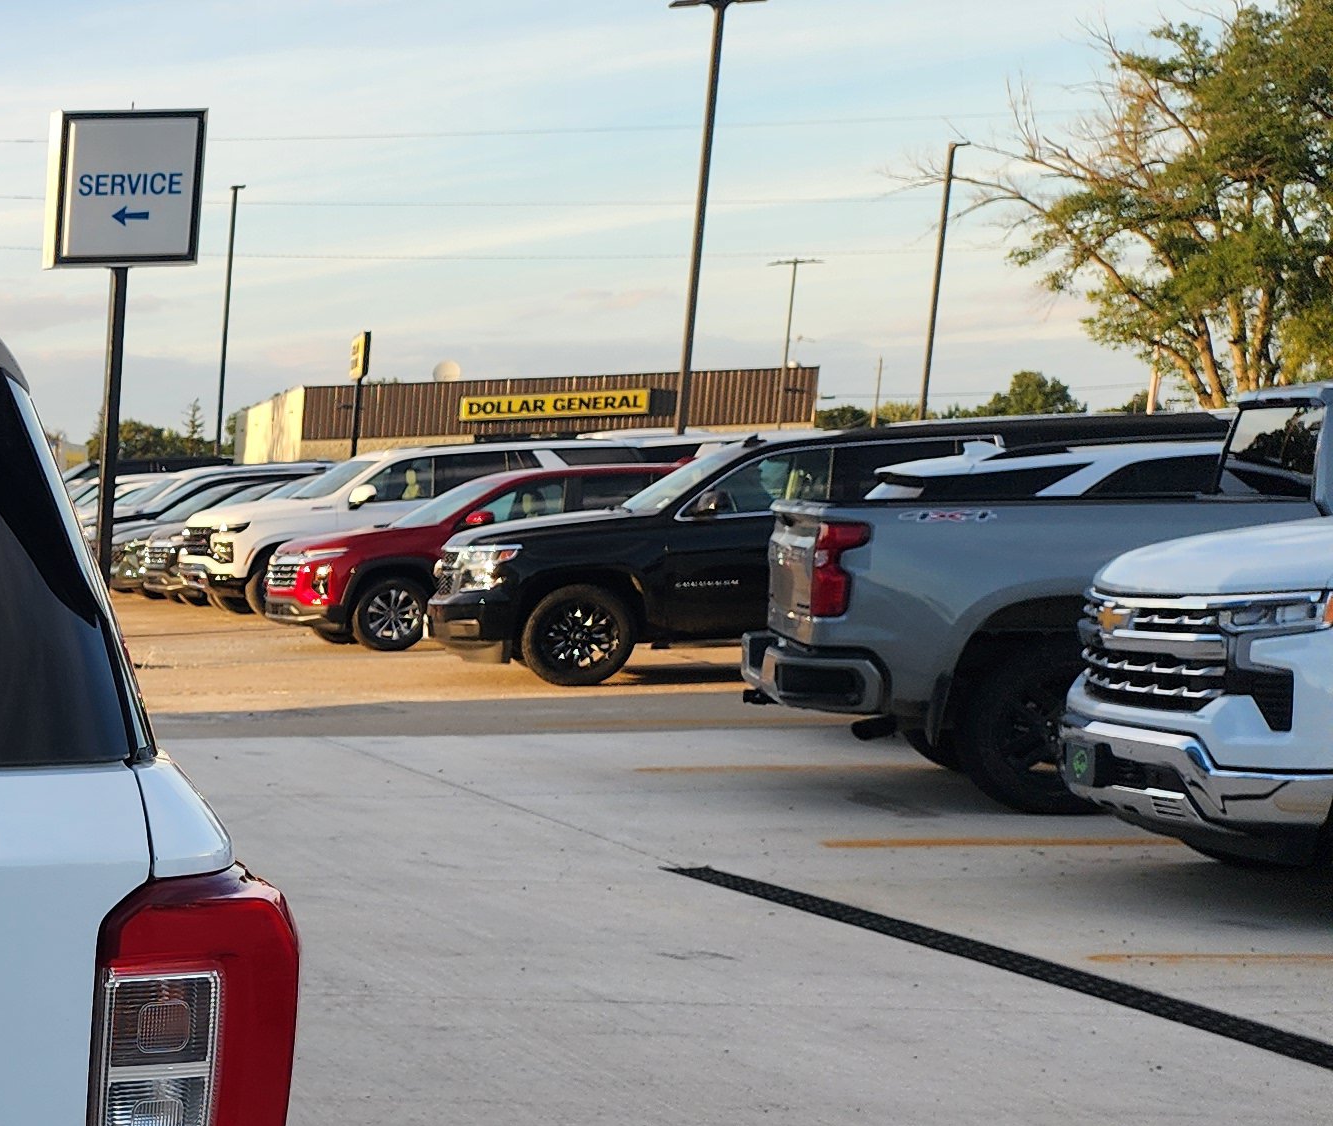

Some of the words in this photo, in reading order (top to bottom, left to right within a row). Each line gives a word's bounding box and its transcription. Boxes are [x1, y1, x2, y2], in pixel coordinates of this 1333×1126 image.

[78, 172, 183, 196] SERVICE
[468, 399, 545, 415] DOLLAR
[552, 395, 642, 411] GENERAL
